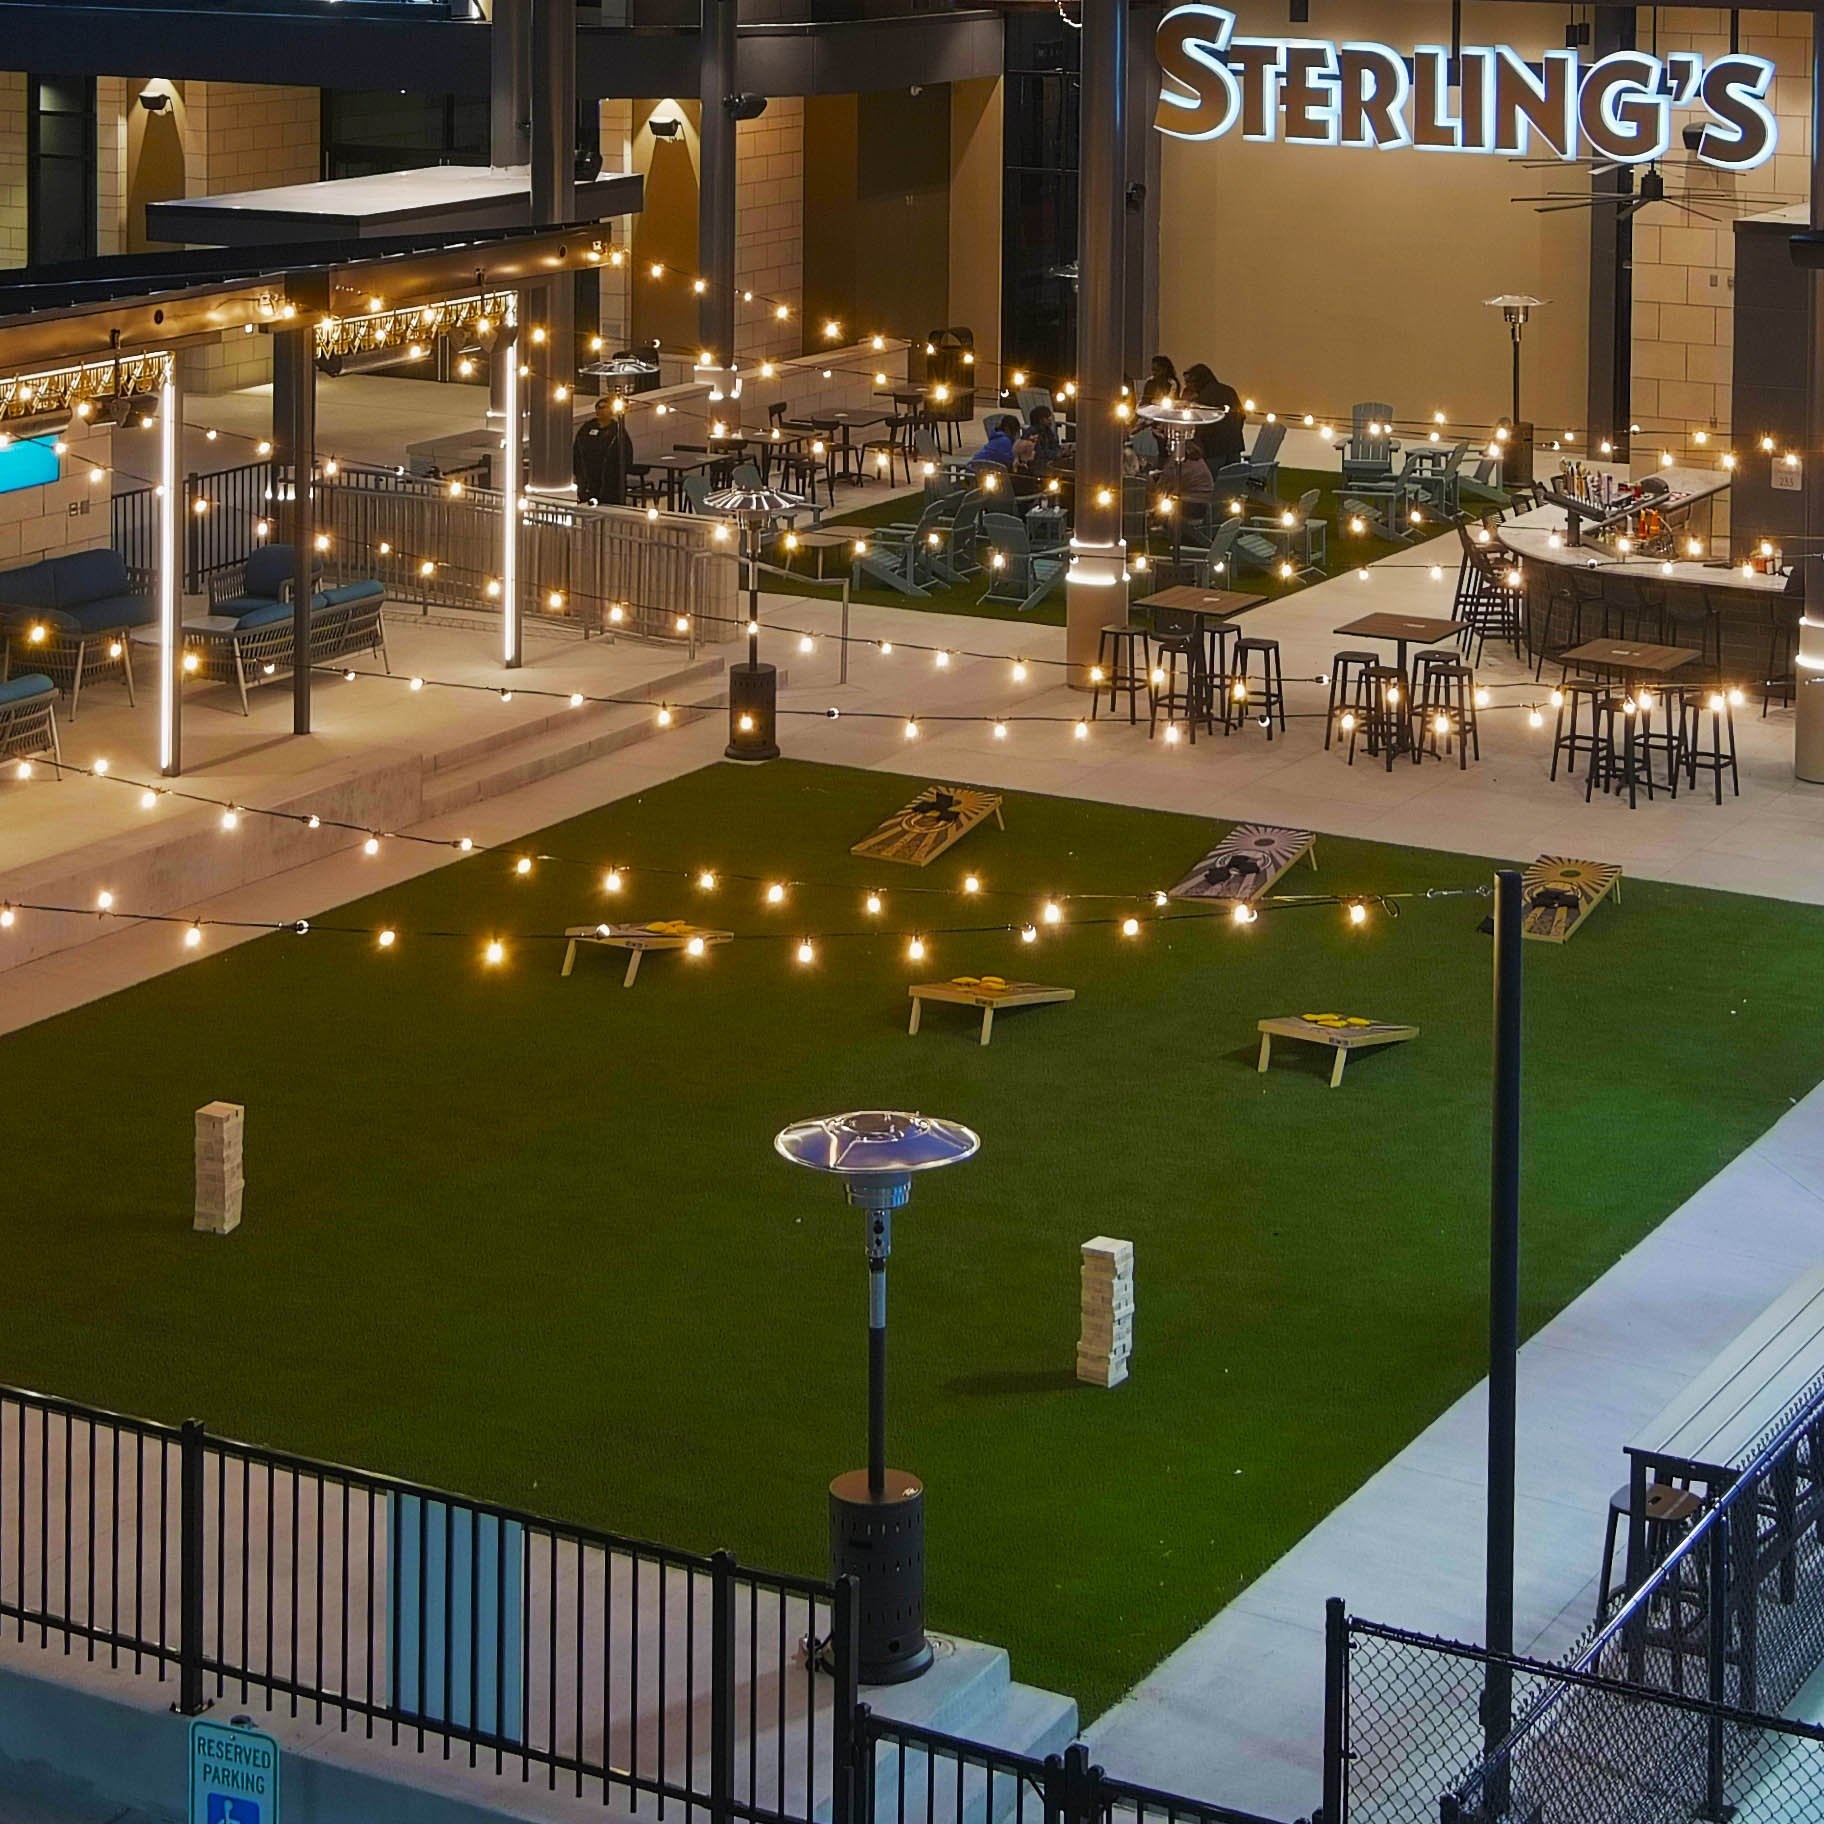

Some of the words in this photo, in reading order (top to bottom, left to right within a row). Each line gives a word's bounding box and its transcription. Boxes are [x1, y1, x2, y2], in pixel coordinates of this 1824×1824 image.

[1152, 2, 1777, 170] STERLING'S
[197, 1735, 272, 1769] RESERVED
[203, 1762, 266, 1795] PARKING
